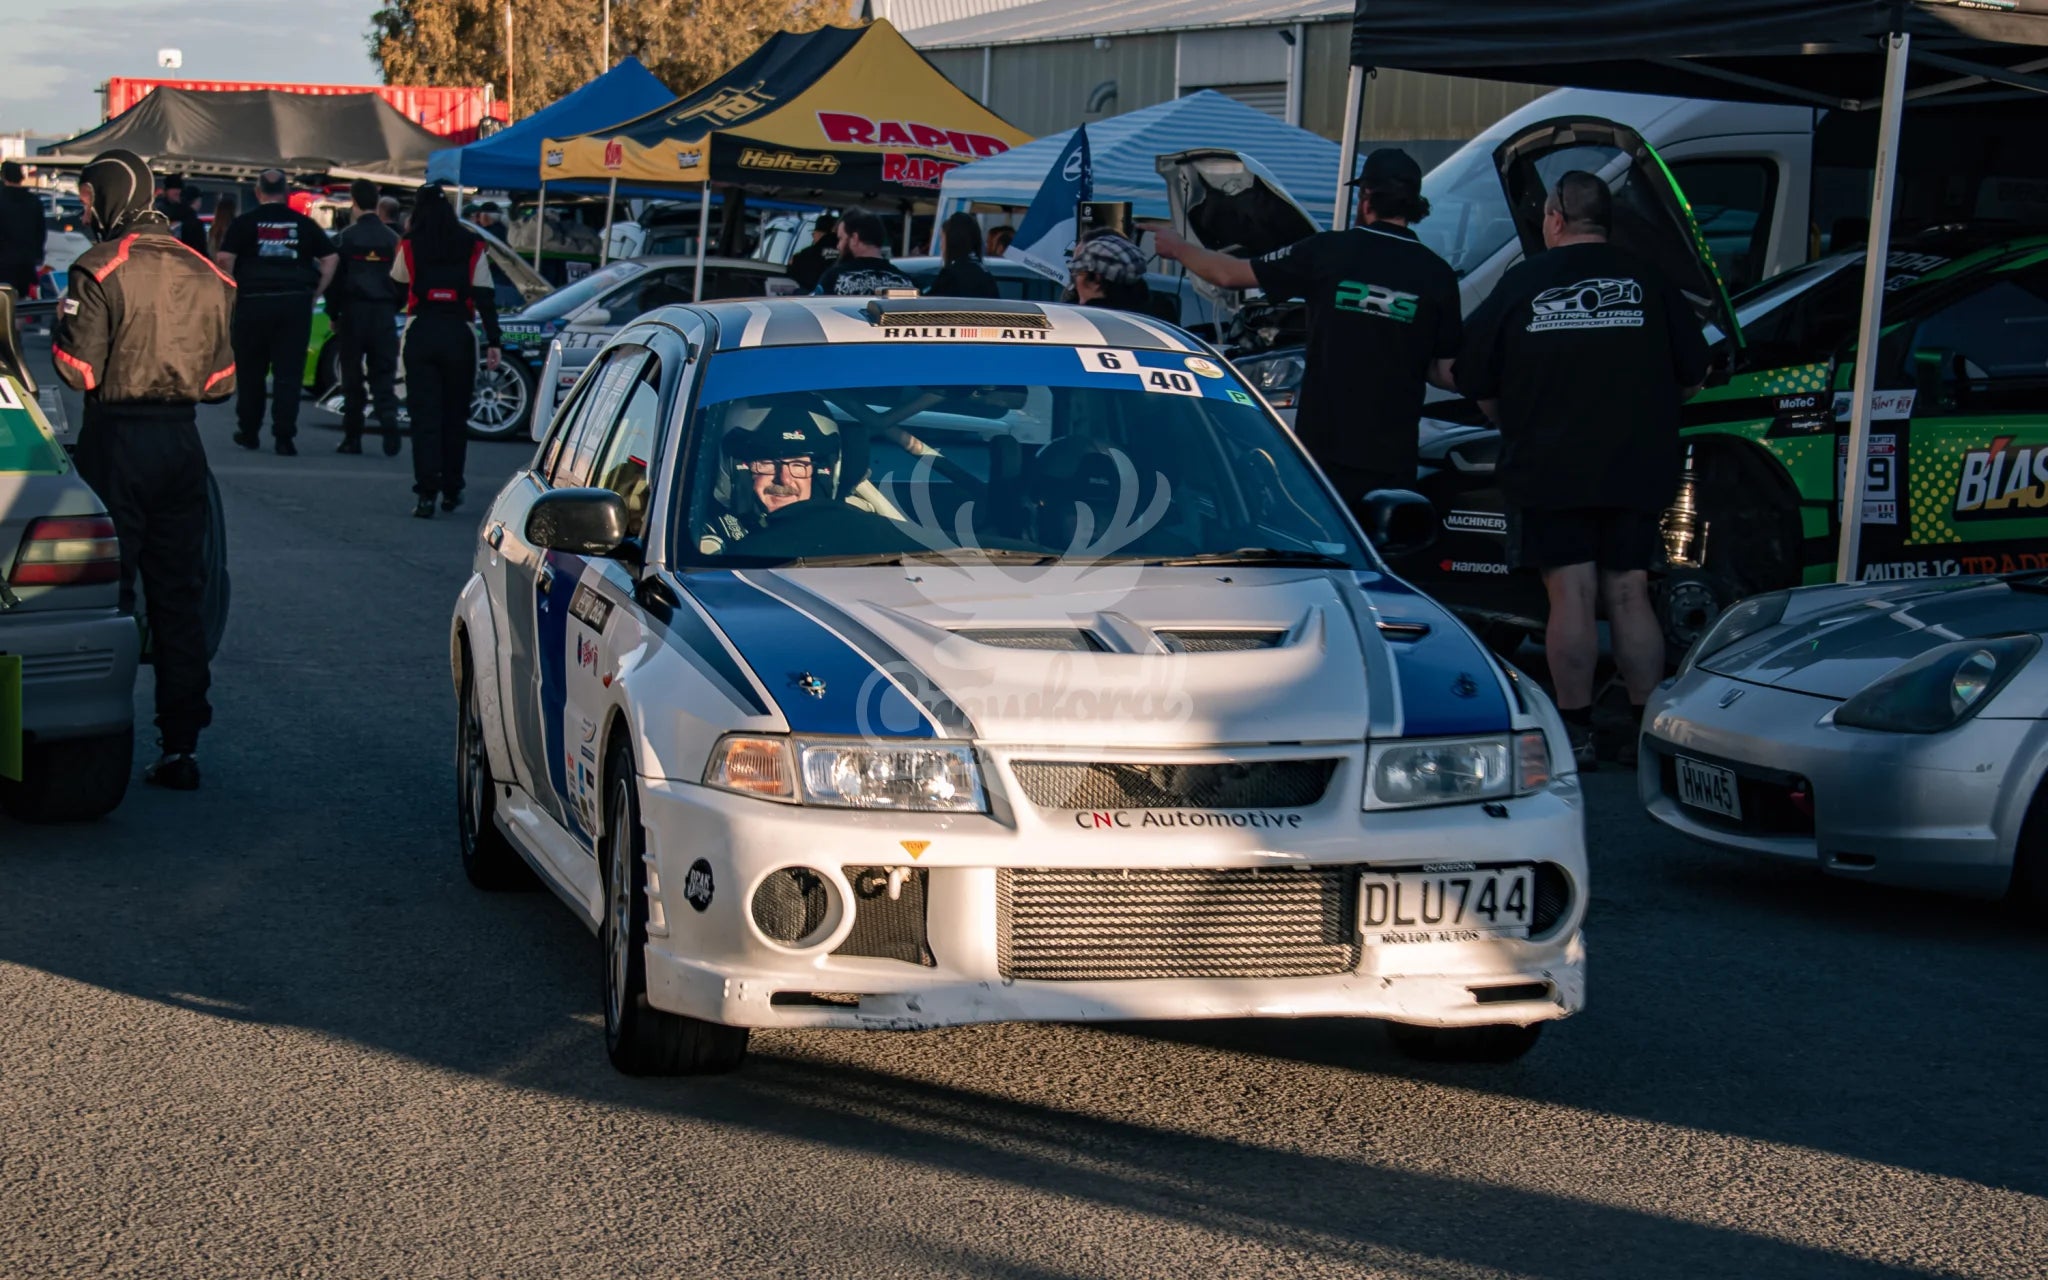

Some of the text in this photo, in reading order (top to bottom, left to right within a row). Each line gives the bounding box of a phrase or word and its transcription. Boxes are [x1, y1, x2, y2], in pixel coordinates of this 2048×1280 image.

[818, 112, 1010, 157] RAPID
[739, 149, 840, 174] Haltech
[1532, 309, 1644, 322] CENTRAL OTAGO
[1535, 319, 1611, 330] MOTORSPORT
[884, 328, 1050, 340] RALLI ART
[1097, 352, 1121, 370] 6
[1150, 371, 1193, 392] 40
[1863, 561, 1928, 581] MITRE
[1932, 559, 1962, 578] 10
[1075, 809, 1302, 829] CNC Automotive
[1364, 875, 1527, 926] DLU744
